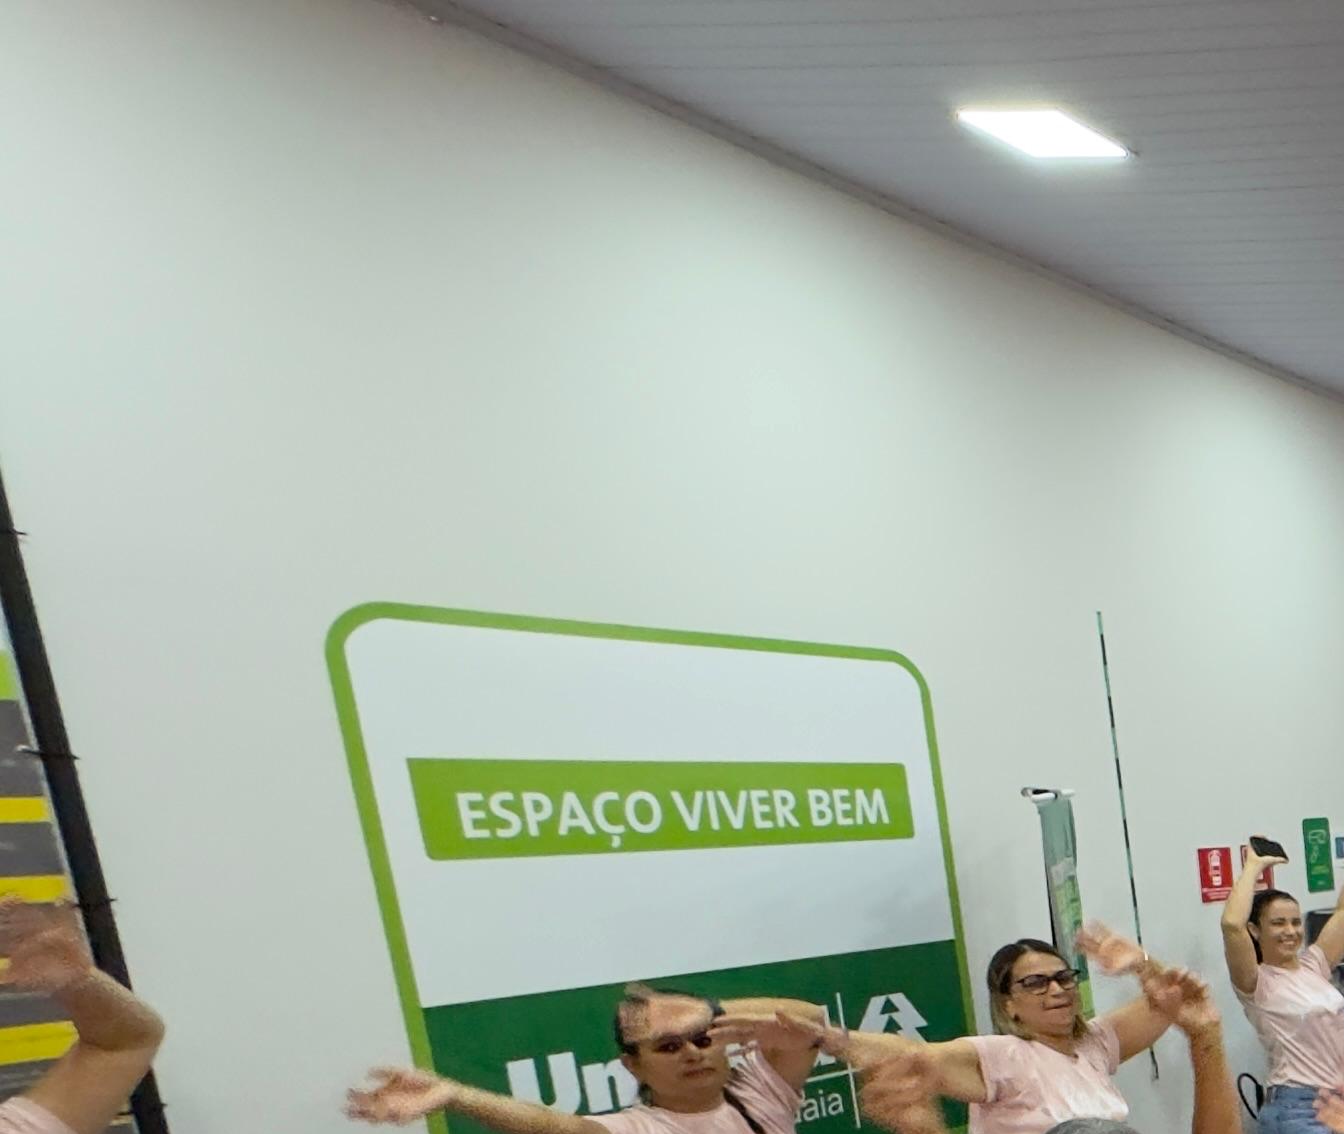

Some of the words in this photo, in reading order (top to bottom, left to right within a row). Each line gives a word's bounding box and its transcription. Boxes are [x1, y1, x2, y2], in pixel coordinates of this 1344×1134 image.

[456, 790, 662, 848] ESPAÇO
[669, 789, 800, 832] VIVER
[807, 788, 889, 828] BEM
